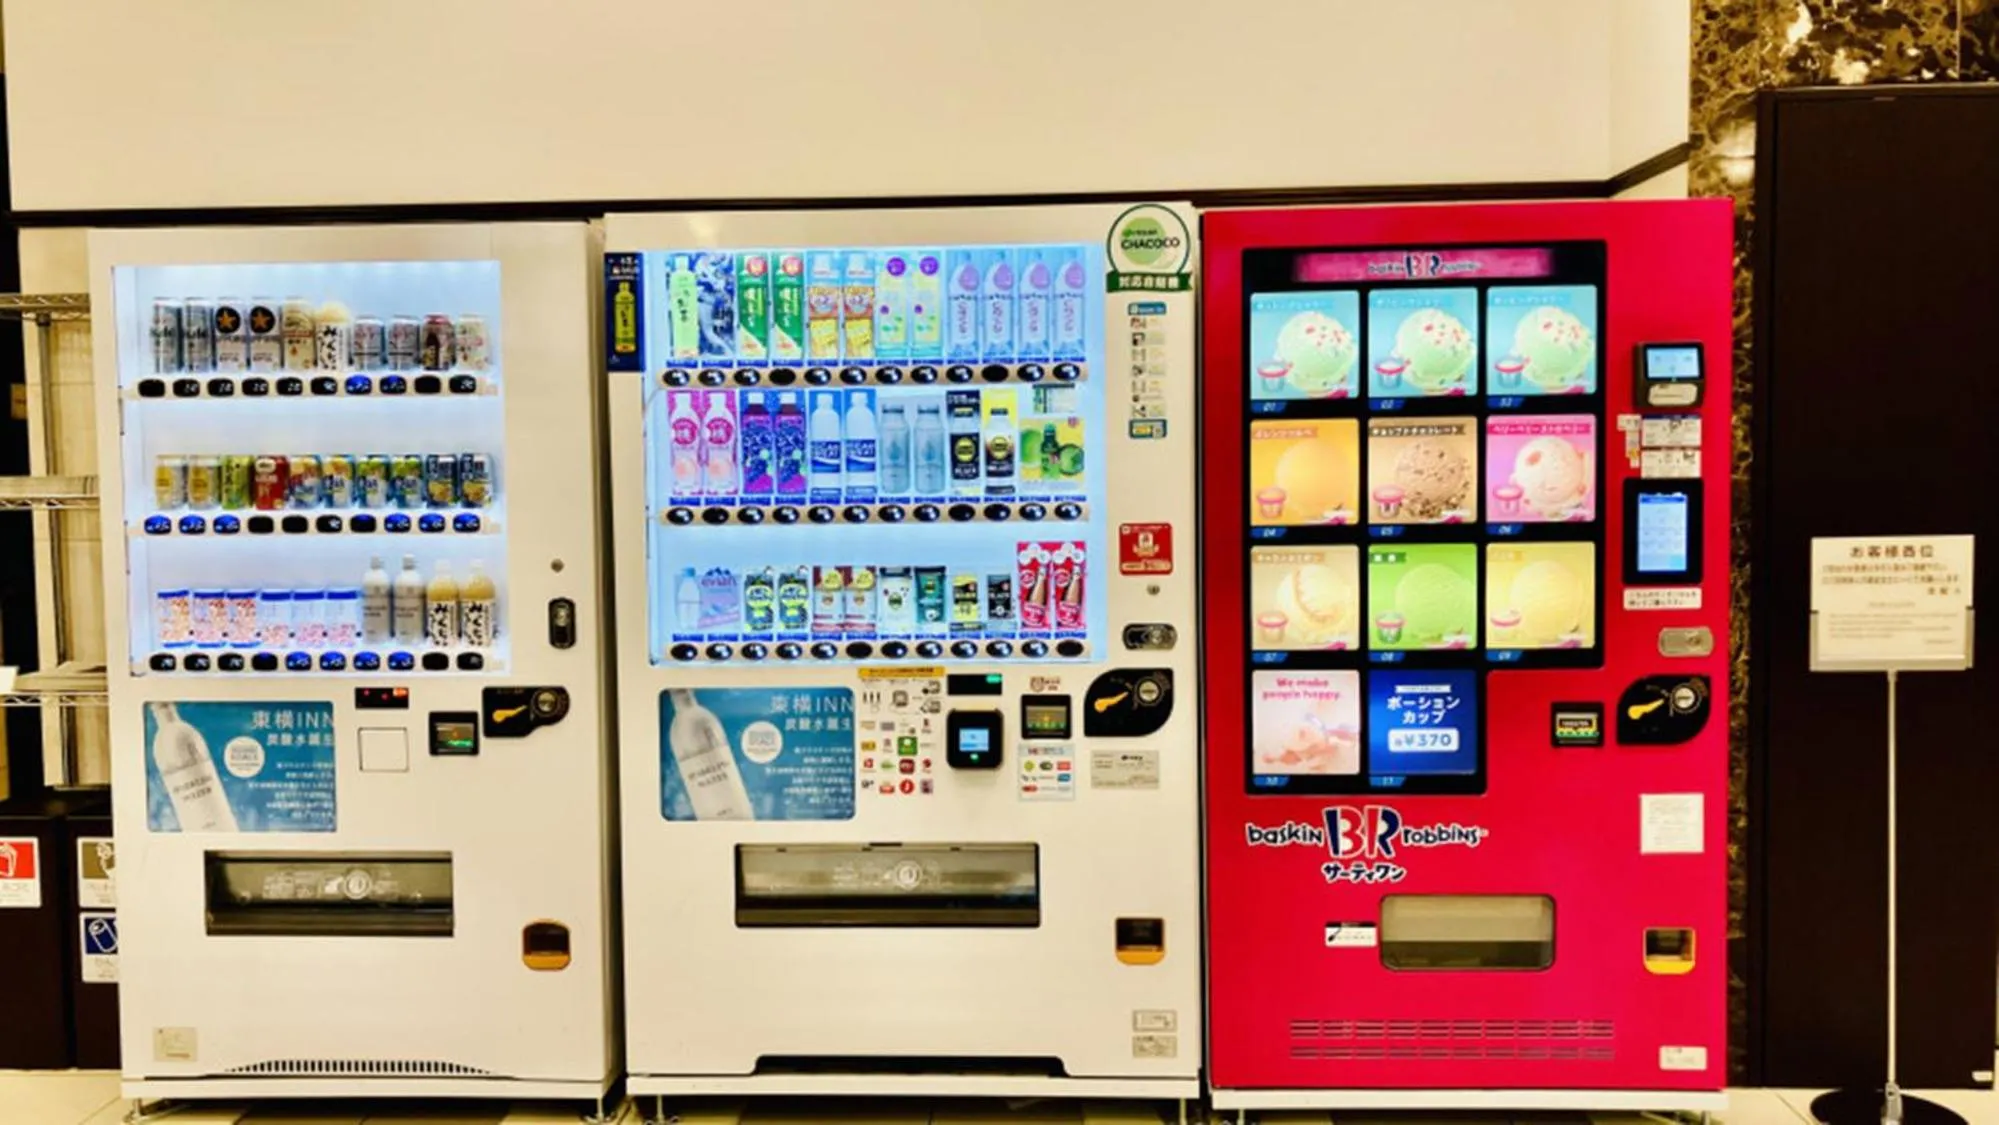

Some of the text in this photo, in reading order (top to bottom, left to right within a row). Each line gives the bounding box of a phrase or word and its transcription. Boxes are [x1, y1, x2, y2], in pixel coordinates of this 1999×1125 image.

[1121, 236, 1180, 250] CHACOCO
[770, 693, 854, 714] 東横INN
[1386, 696, 1461, 711] ポーション
[251, 710, 334, 731] 東横INN
[1402, 709, 1446, 725] カップ
[1247, 806, 1481, 858] baskin BR robbins
[1322, 863, 1407, 883] サーティワン
